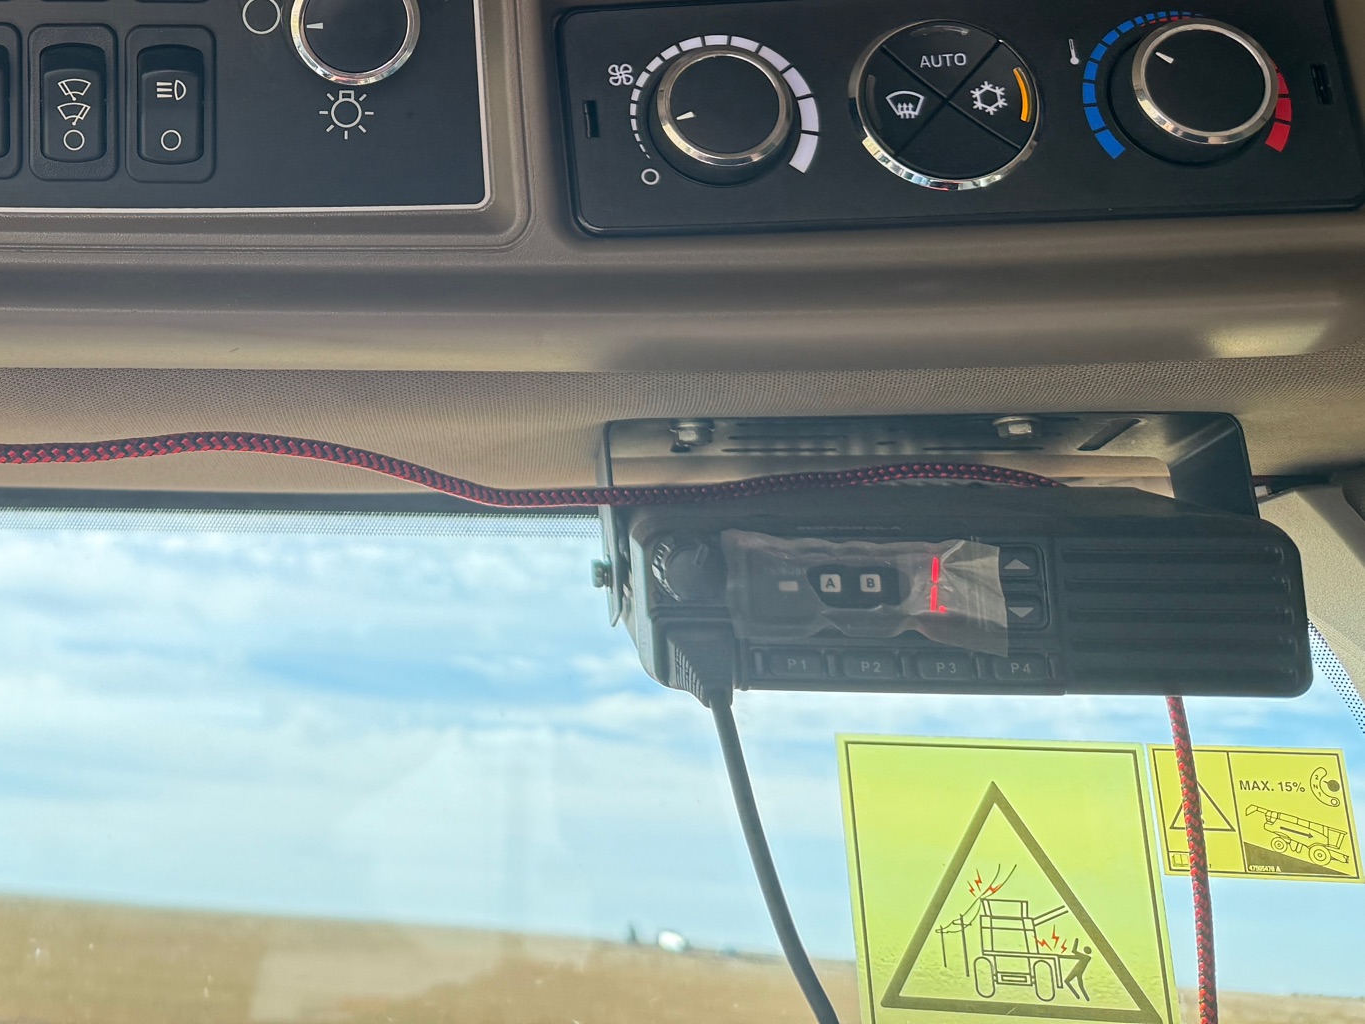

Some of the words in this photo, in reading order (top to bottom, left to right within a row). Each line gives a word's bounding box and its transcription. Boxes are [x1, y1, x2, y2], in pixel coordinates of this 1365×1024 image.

[919, 52, 967, 69] AUTO
[787, 658, 807, 671] P1
[861, 661, 882, 674] P2
[936, 662, 957, 674] P3
[1010, 663, 1031, 675] P4
[1239, 779, 1275, 792] MAX.
[1278, 780, 1306, 793] 15%
